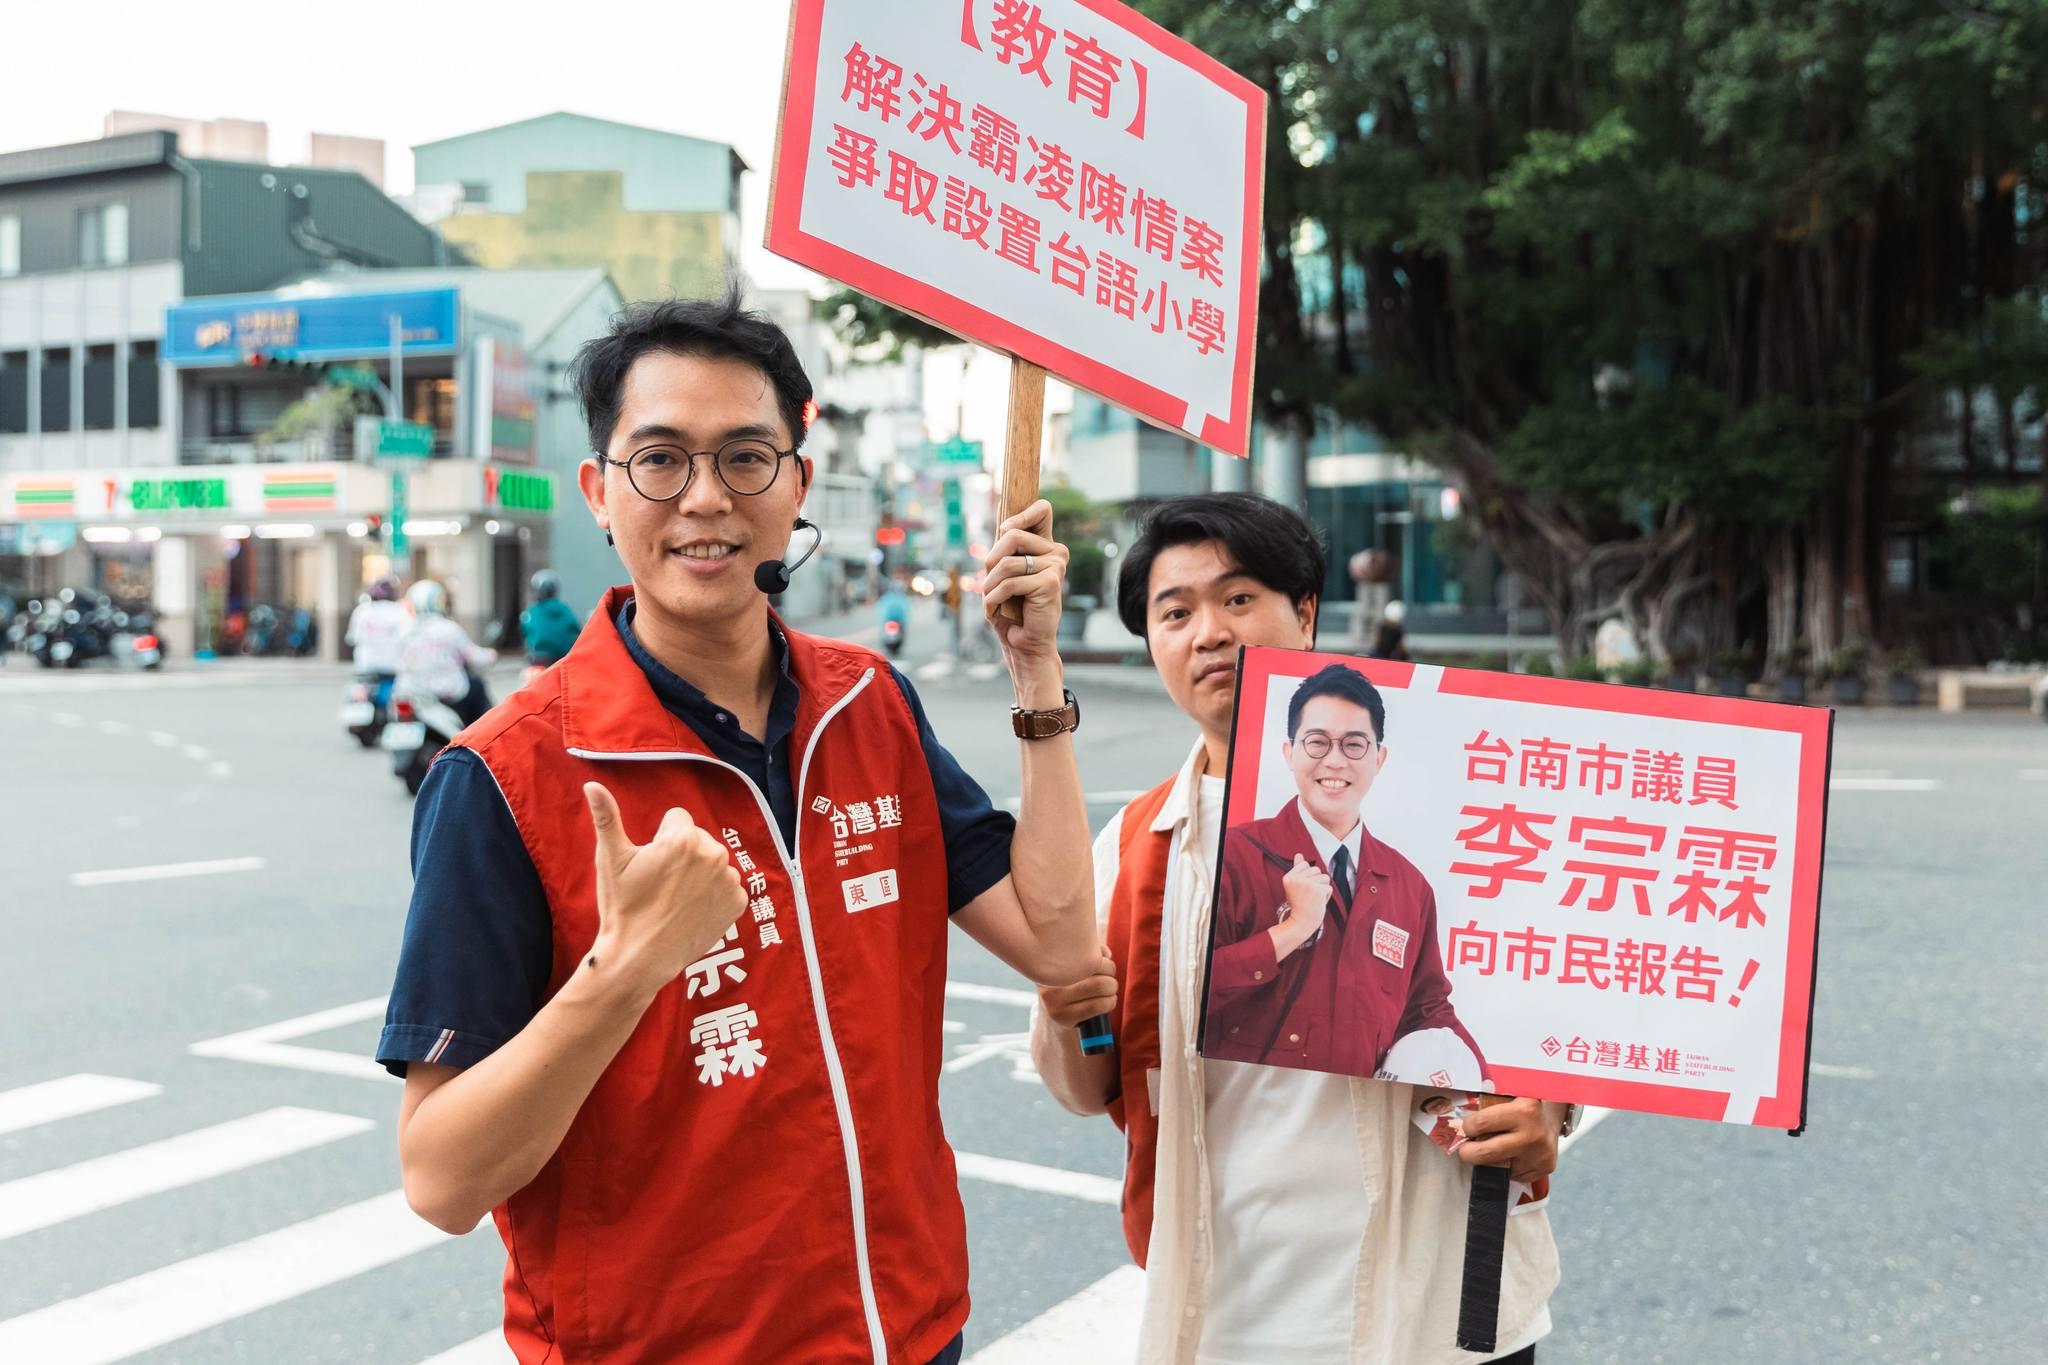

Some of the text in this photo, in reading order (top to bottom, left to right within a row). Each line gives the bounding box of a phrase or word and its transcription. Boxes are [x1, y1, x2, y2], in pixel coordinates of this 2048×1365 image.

[840, 41, 1224, 287] 解決霸凌陳情案
[826, 123, 1225, 355] 爭取設置台語小學
[1463, 730, 1740, 810] 台南市議員
[1449, 803, 1777, 929] 李宗霖
[1446, 920, 1760, 1009] 向市民報告！
[1566, 1036, 1680, 1074] 台灣基進
